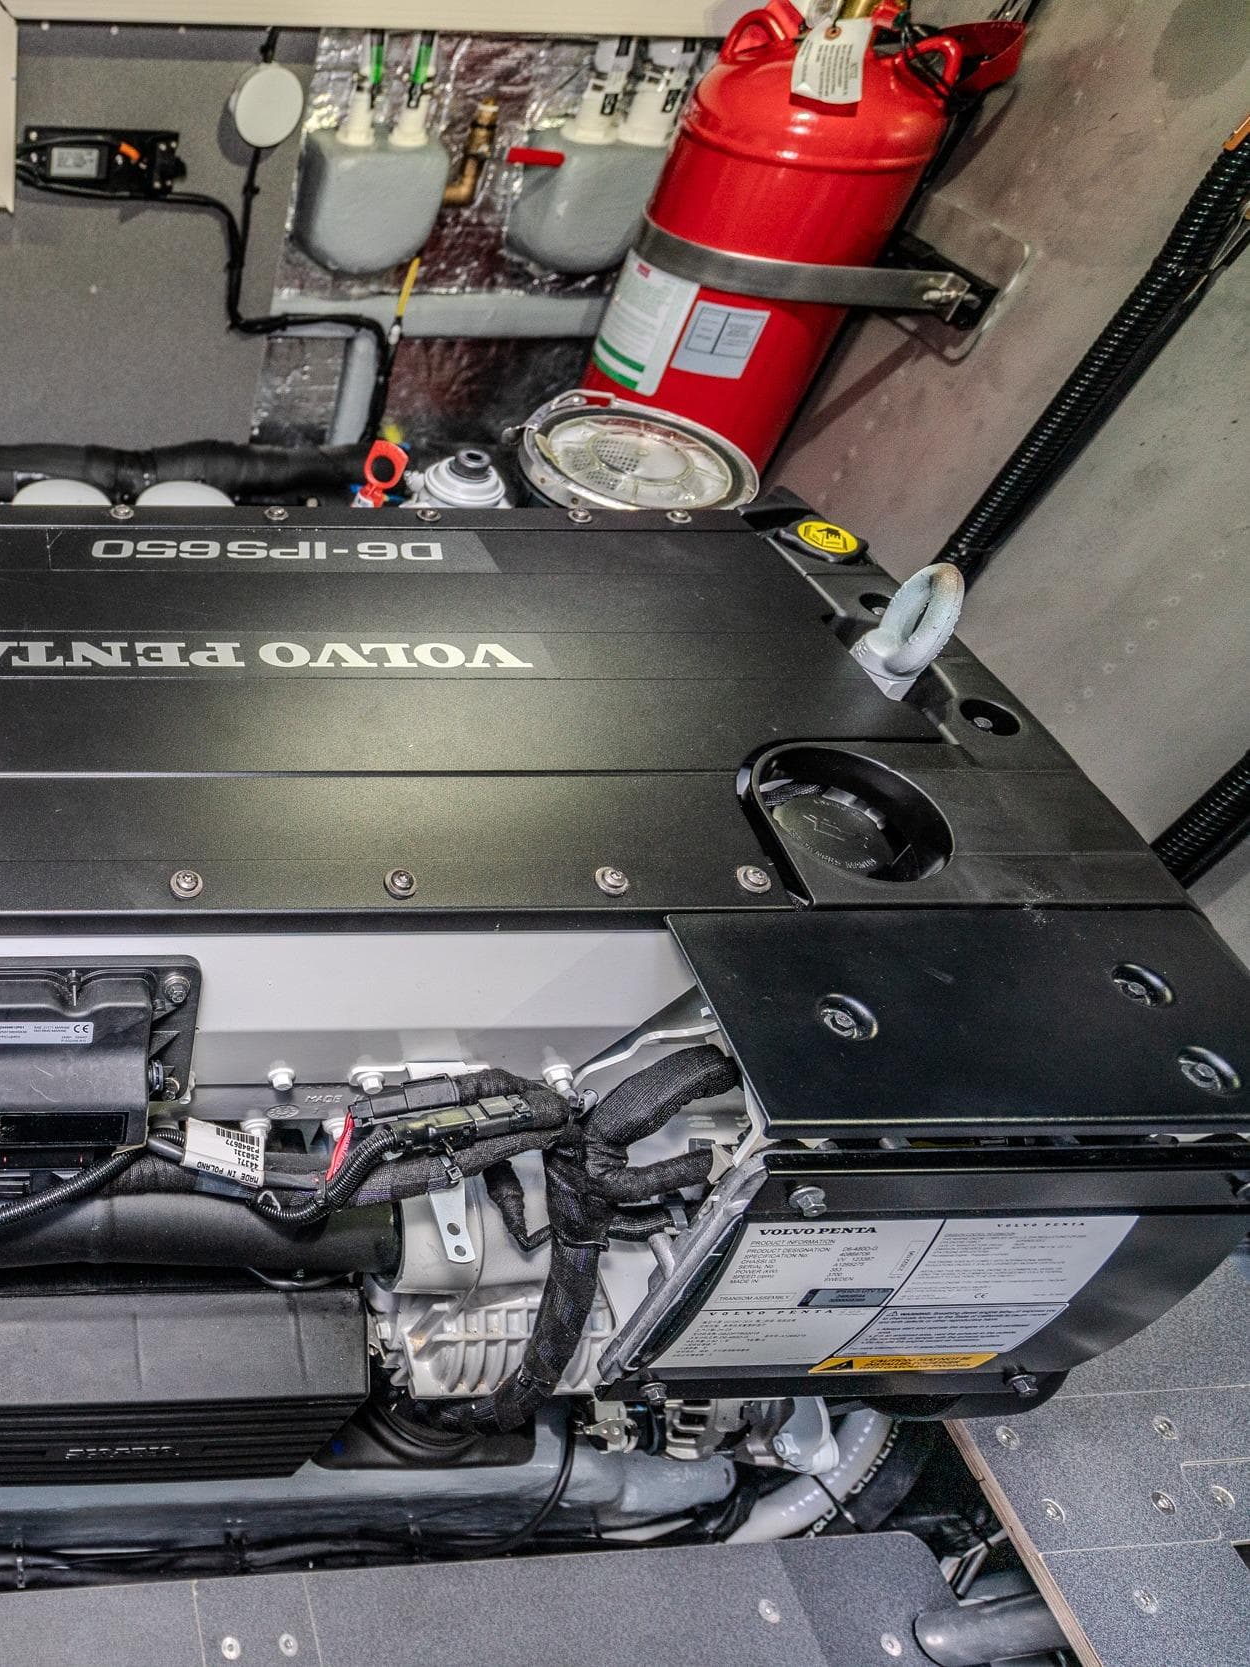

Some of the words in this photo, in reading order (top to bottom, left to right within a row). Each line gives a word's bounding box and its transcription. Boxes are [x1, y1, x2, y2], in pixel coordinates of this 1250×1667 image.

[91, 539, 444, 561] D6-IPS650
[259, 642, 534, 668] VOLVO
[196, 1161, 224, 1175] POLAND
[226, 1169, 236, 1178] IN
[239, 1172, 259, 1184] MADE
[759, 1228, 815, 1236] VOLVO
[817, 1226, 878, 1235] PENTA
